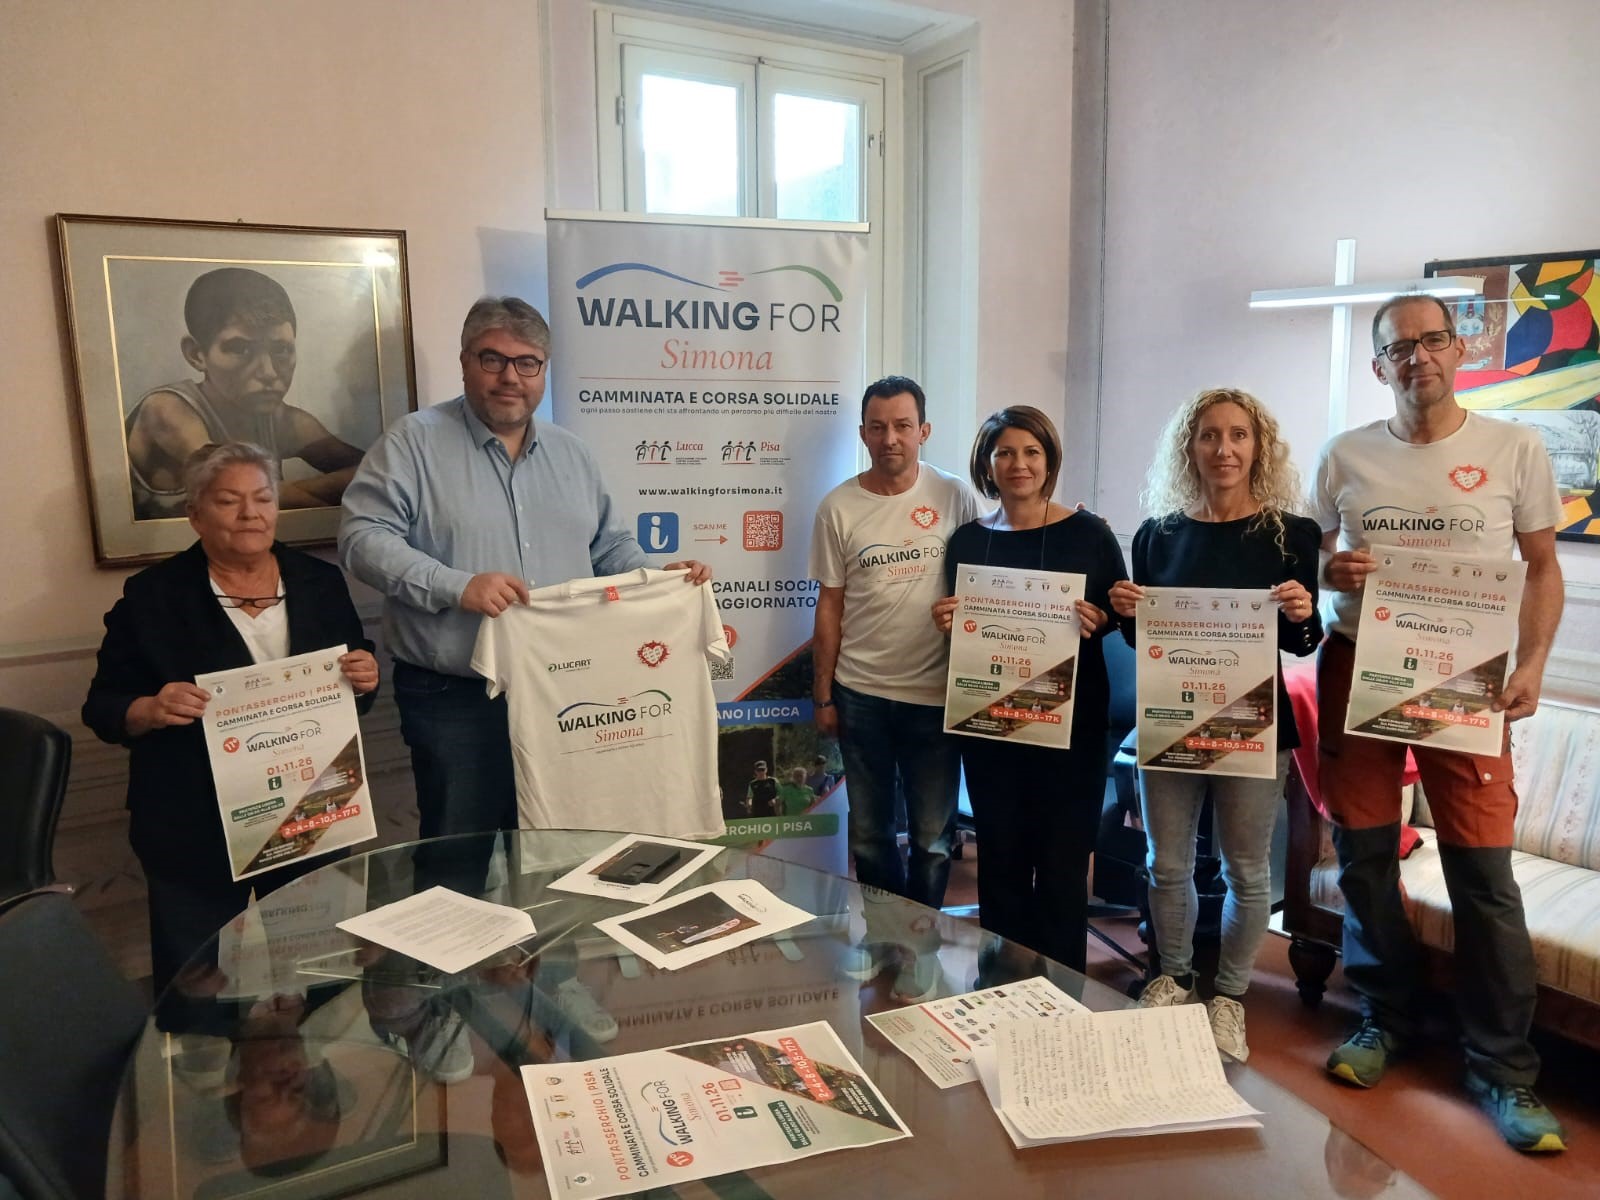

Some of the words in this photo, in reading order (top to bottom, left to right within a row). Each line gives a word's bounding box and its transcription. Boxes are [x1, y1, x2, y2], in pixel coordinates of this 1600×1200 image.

[576, 297, 760, 330] WALKING
[770, 304, 840, 332] FOR
[660, 338, 773, 370] Simona
[579, 390, 684, 404] CAMMINATA
[690, 392, 698, 404] E
[702, 392, 759, 404] CORSA
[763, 392, 840, 406] SOLIDALE
[675, 441, 704, 451] Lucca
[760, 441, 780, 452] Pisa
[638, 486, 783, 496] www.walkingforsimona.it
[1362, 518, 1445, 531] WALKING
[1450, 518, 1485, 532] FOR
[1398, 534, 1451, 548] Simona
[858, 549, 921, 569] WALKING
[923, 546, 946, 558] FOR
[888, 564, 927, 578] Simona
[712, 580, 770, 594] CANALI
[1378, 580, 1470, 598] PONTASSERCHIO
[1480, 592, 1507, 602] PISA
[964, 596, 1041, 609] PONTASSERCHIO
[1050, 603, 1072, 612] PISA
[1376, 589, 1426, 602] CAMMINATA
[1434, 596, 1464, 606] CORSA
[1466, 600, 1506, 612] SOLIDALE
[964, 604, 1006, 614] CAMMINATA
[1038, 612, 1071, 620] SOLIDALE
[1147, 620, 1232, 629] PONTASSERCHIO
[1242, 622, 1265, 630] PISA
[1396, 620, 1448, 634] WALKING
[1450, 626, 1474, 638] FOR
[982, 631, 1025, 642] WALKING
[1026, 635, 1046, 644] FOR
[992, 655, 1032, 666] 01.11.26
[1168, 656, 1217, 666] WALKING
[1218, 658, 1240, 667] FOR
[1406, 647, 1454, 662] 01.11.26
[558, 659, 592, 670] LUCART
[1182, 681, 1226, 691] 01.11.26
[216, 691, 306, 717] PONTASSERCHIO
[316, 683, 340, 694] PISA
[216, 710, 268, 728] CAMMINATA
[276, 702, 304, 714] CORSA
[305, 692, 342, 706] SOLIDALE
[558, 708, 636, 732] WALKING
[640, 703, 672, 719] FOR
[754, 706, 800, 718] LUCCA
[246, 733, 298, 752] WALKING
[300, 726, 322, 739] FOR
[594, 726, 644, 744] Simona
[267, 757, 312, 776] 01.11.26
[783, 822, 813, 832] PISA
[584, 1070, 599, 1091] PISA
[600, 1068, 619, 1099] SOLIDALE
[654, 1080, 673, 1099] FOR
[612, 1098, 629, 1124] CORSA
[702, 1082, 732, 1122] 01.11.26
[662, 1099, 694, 1145] WALKING
[593, 1098, 631, 1181] PONTASSERCHIO
[623, 1130, 650, 1178] CAMMINATA
